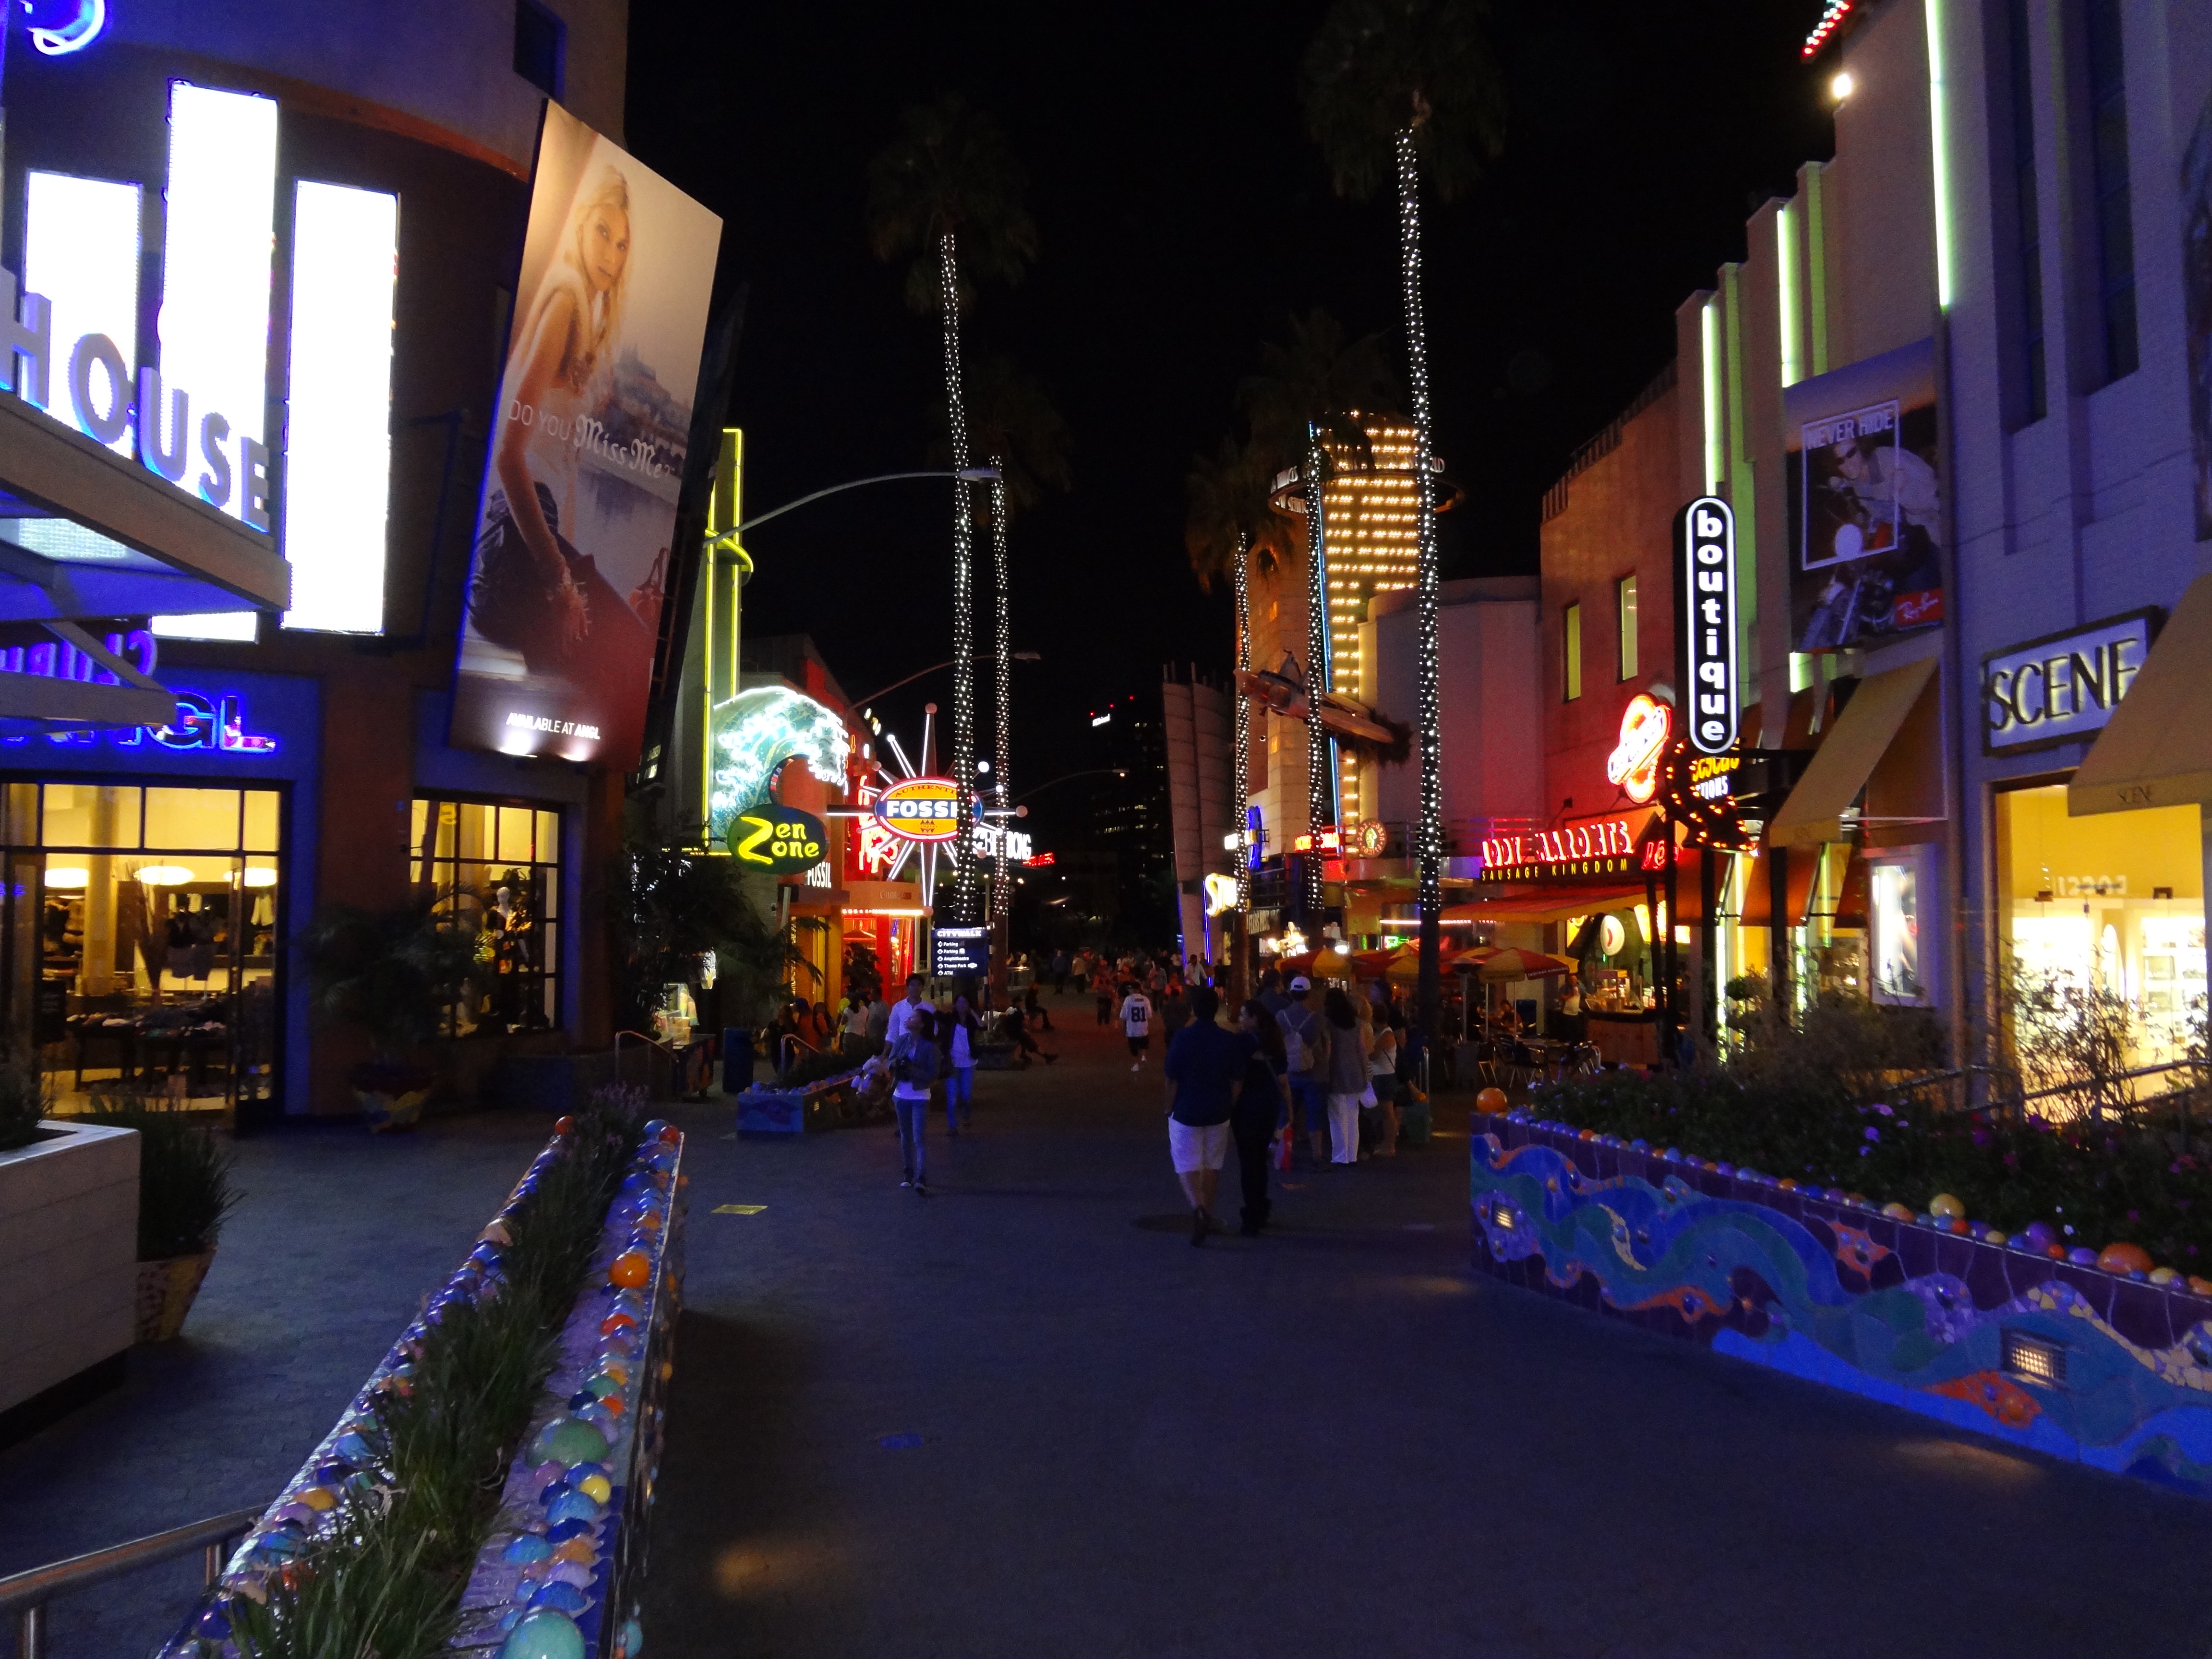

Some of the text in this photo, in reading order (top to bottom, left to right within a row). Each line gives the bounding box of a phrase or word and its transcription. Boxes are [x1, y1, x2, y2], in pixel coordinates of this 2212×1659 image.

[0, 265, 270, 534] HOUSE
[509, 400, 532, 426] DO
[539, 412, 571, 440] YOU
[574, 415, 627, 463] Miss
[1805, 409, 1895, 450] NEVER HIDE
[1696, 509, 1725, 742] boutique
[505, 712, 601, 740] AVAILABLE AT ANGL
[895, 784, 957, 798] AUTHENTI
[887, 800, 958, 818] FOSSI
[1482, 858, 1628, 881] SAUSAGE KINGDOM
[1131, 1006, 1146, 1022] 81
